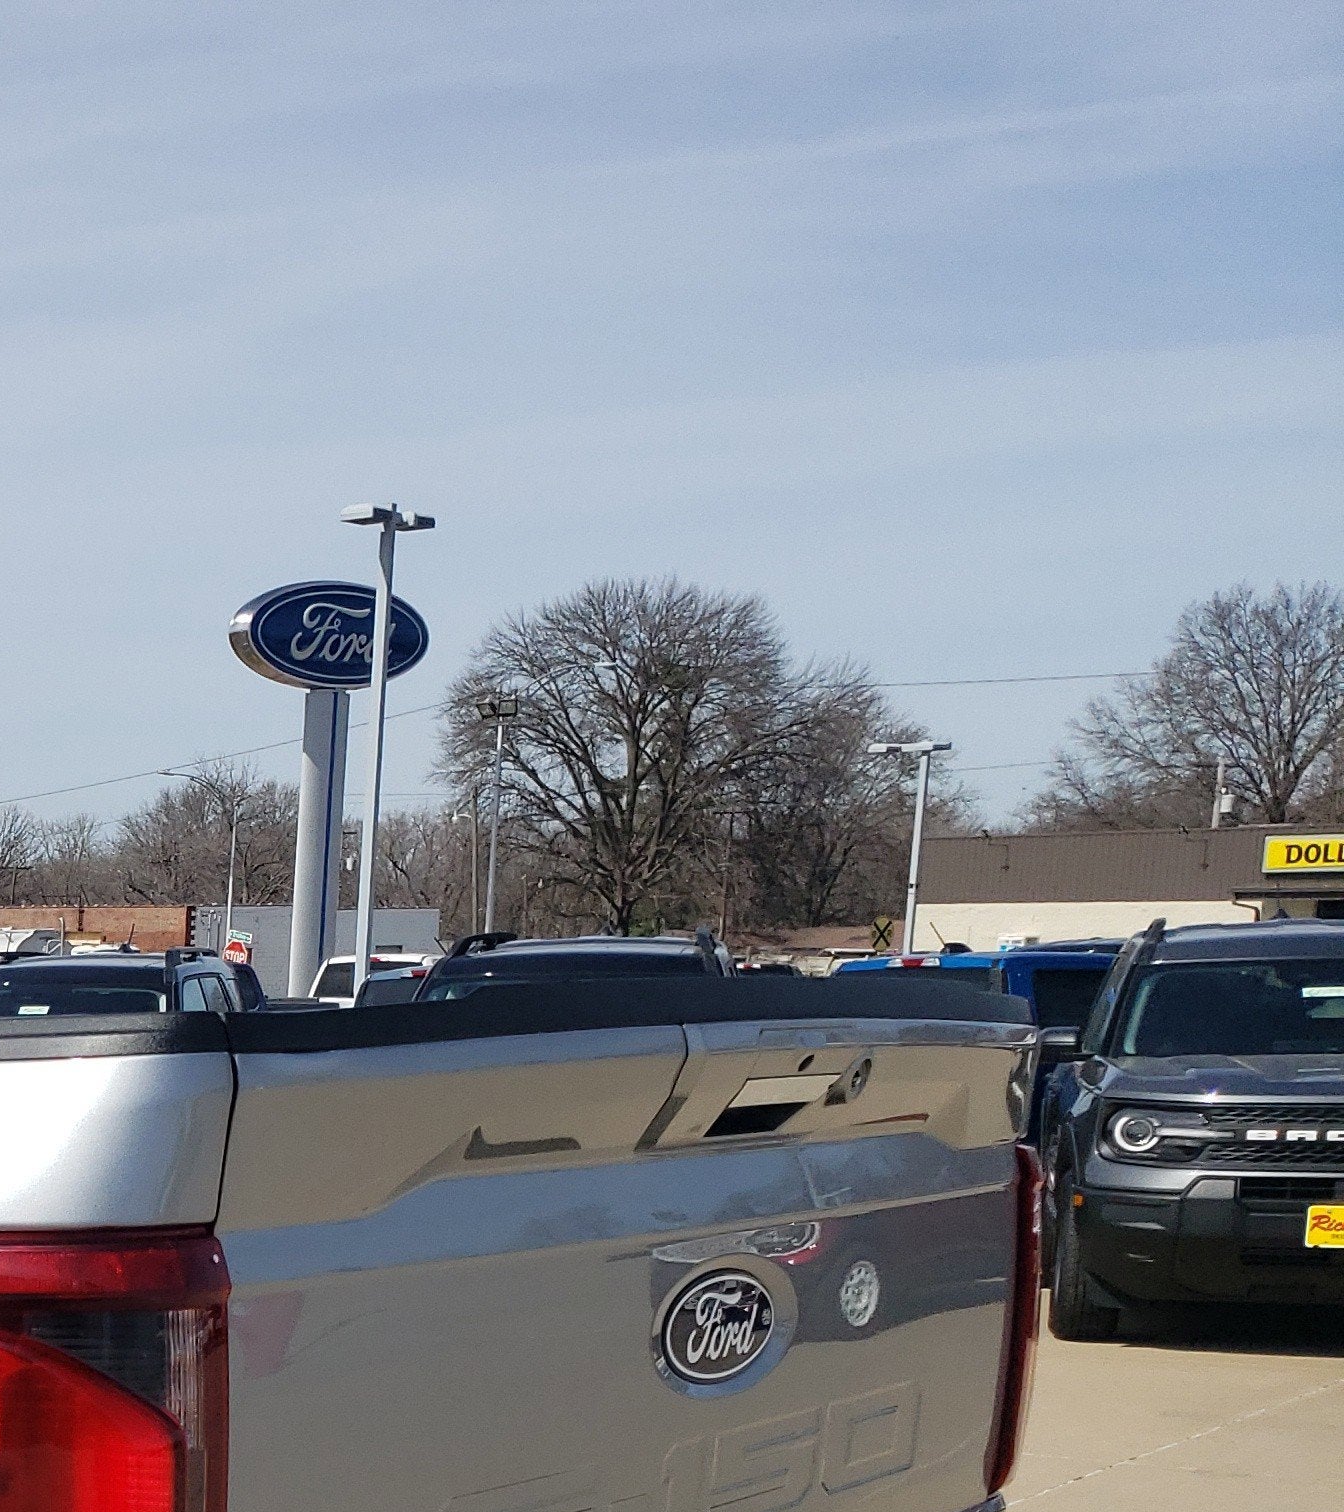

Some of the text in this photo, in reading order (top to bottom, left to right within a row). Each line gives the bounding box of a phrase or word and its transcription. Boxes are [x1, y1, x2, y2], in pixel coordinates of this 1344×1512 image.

[225, 950, 246, 963] STOP
[1310, 1214, 1344, 1231] Ric
[687, 1291, 759, 1364] Ford
